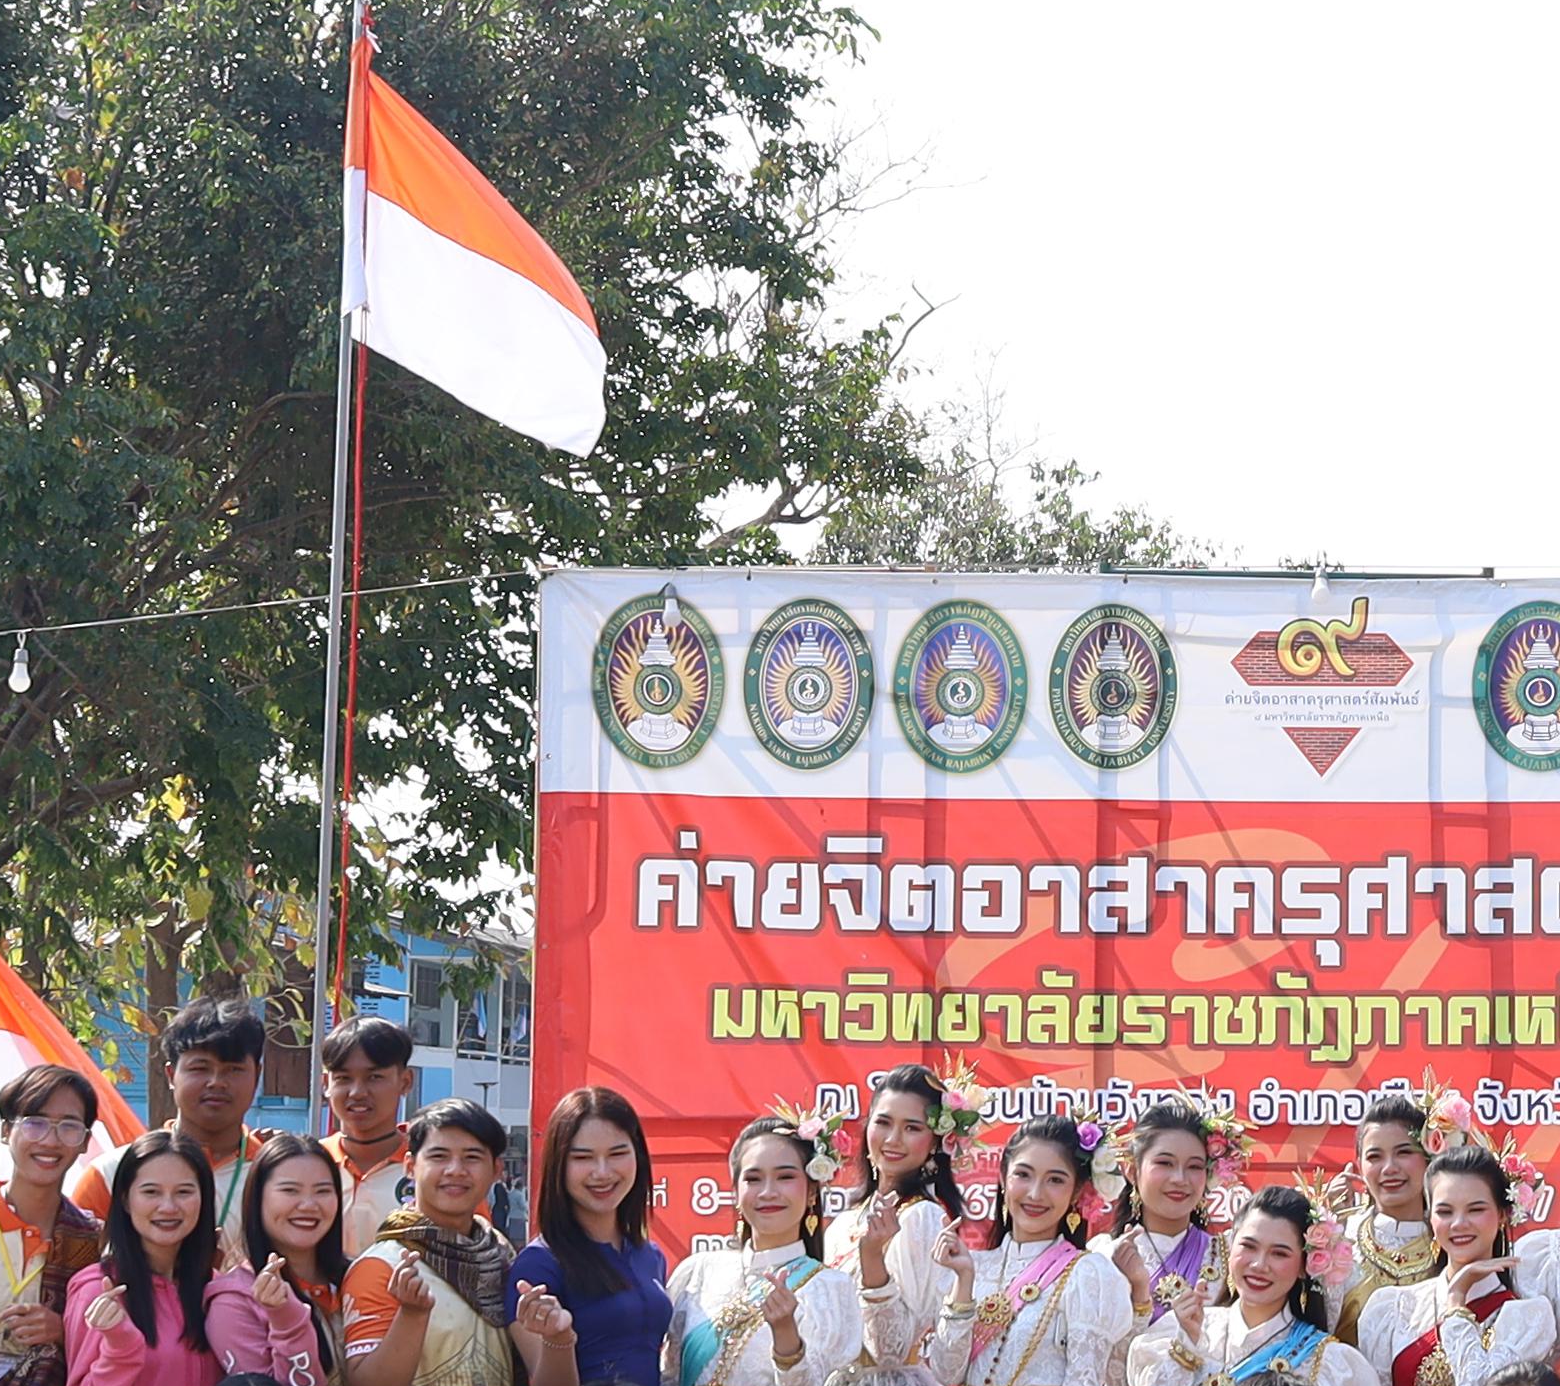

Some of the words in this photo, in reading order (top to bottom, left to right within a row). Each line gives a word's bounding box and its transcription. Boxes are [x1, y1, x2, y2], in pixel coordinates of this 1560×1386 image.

[1275, 596, 1369, 679] ๙
[648, 741, 701, 767] RAJABHAT
[701, 673, 722, 737] UNIVERSITY
[749, 704, 767, 744] NAKHON
[766, 740, 791, 762] SAWAN
[795, 751, 833, 768] RAJABHAT
[835, 706, 867, 754] UNIVERSITY
[944, 750, 994, 772] RAJABHAT
[993, 693, 1023, 750] UNIVERSITY
[1051, 688, 1086, 755] PHETCHABUN
[1087, 749, 1146, 767] RAJABHAT
[1146, 691, 1175, 747] UNIVERSITY
[1224, 690, 1420, 711] ค่ายจิตอาสาครุศาสตร์สัมพันธ์
